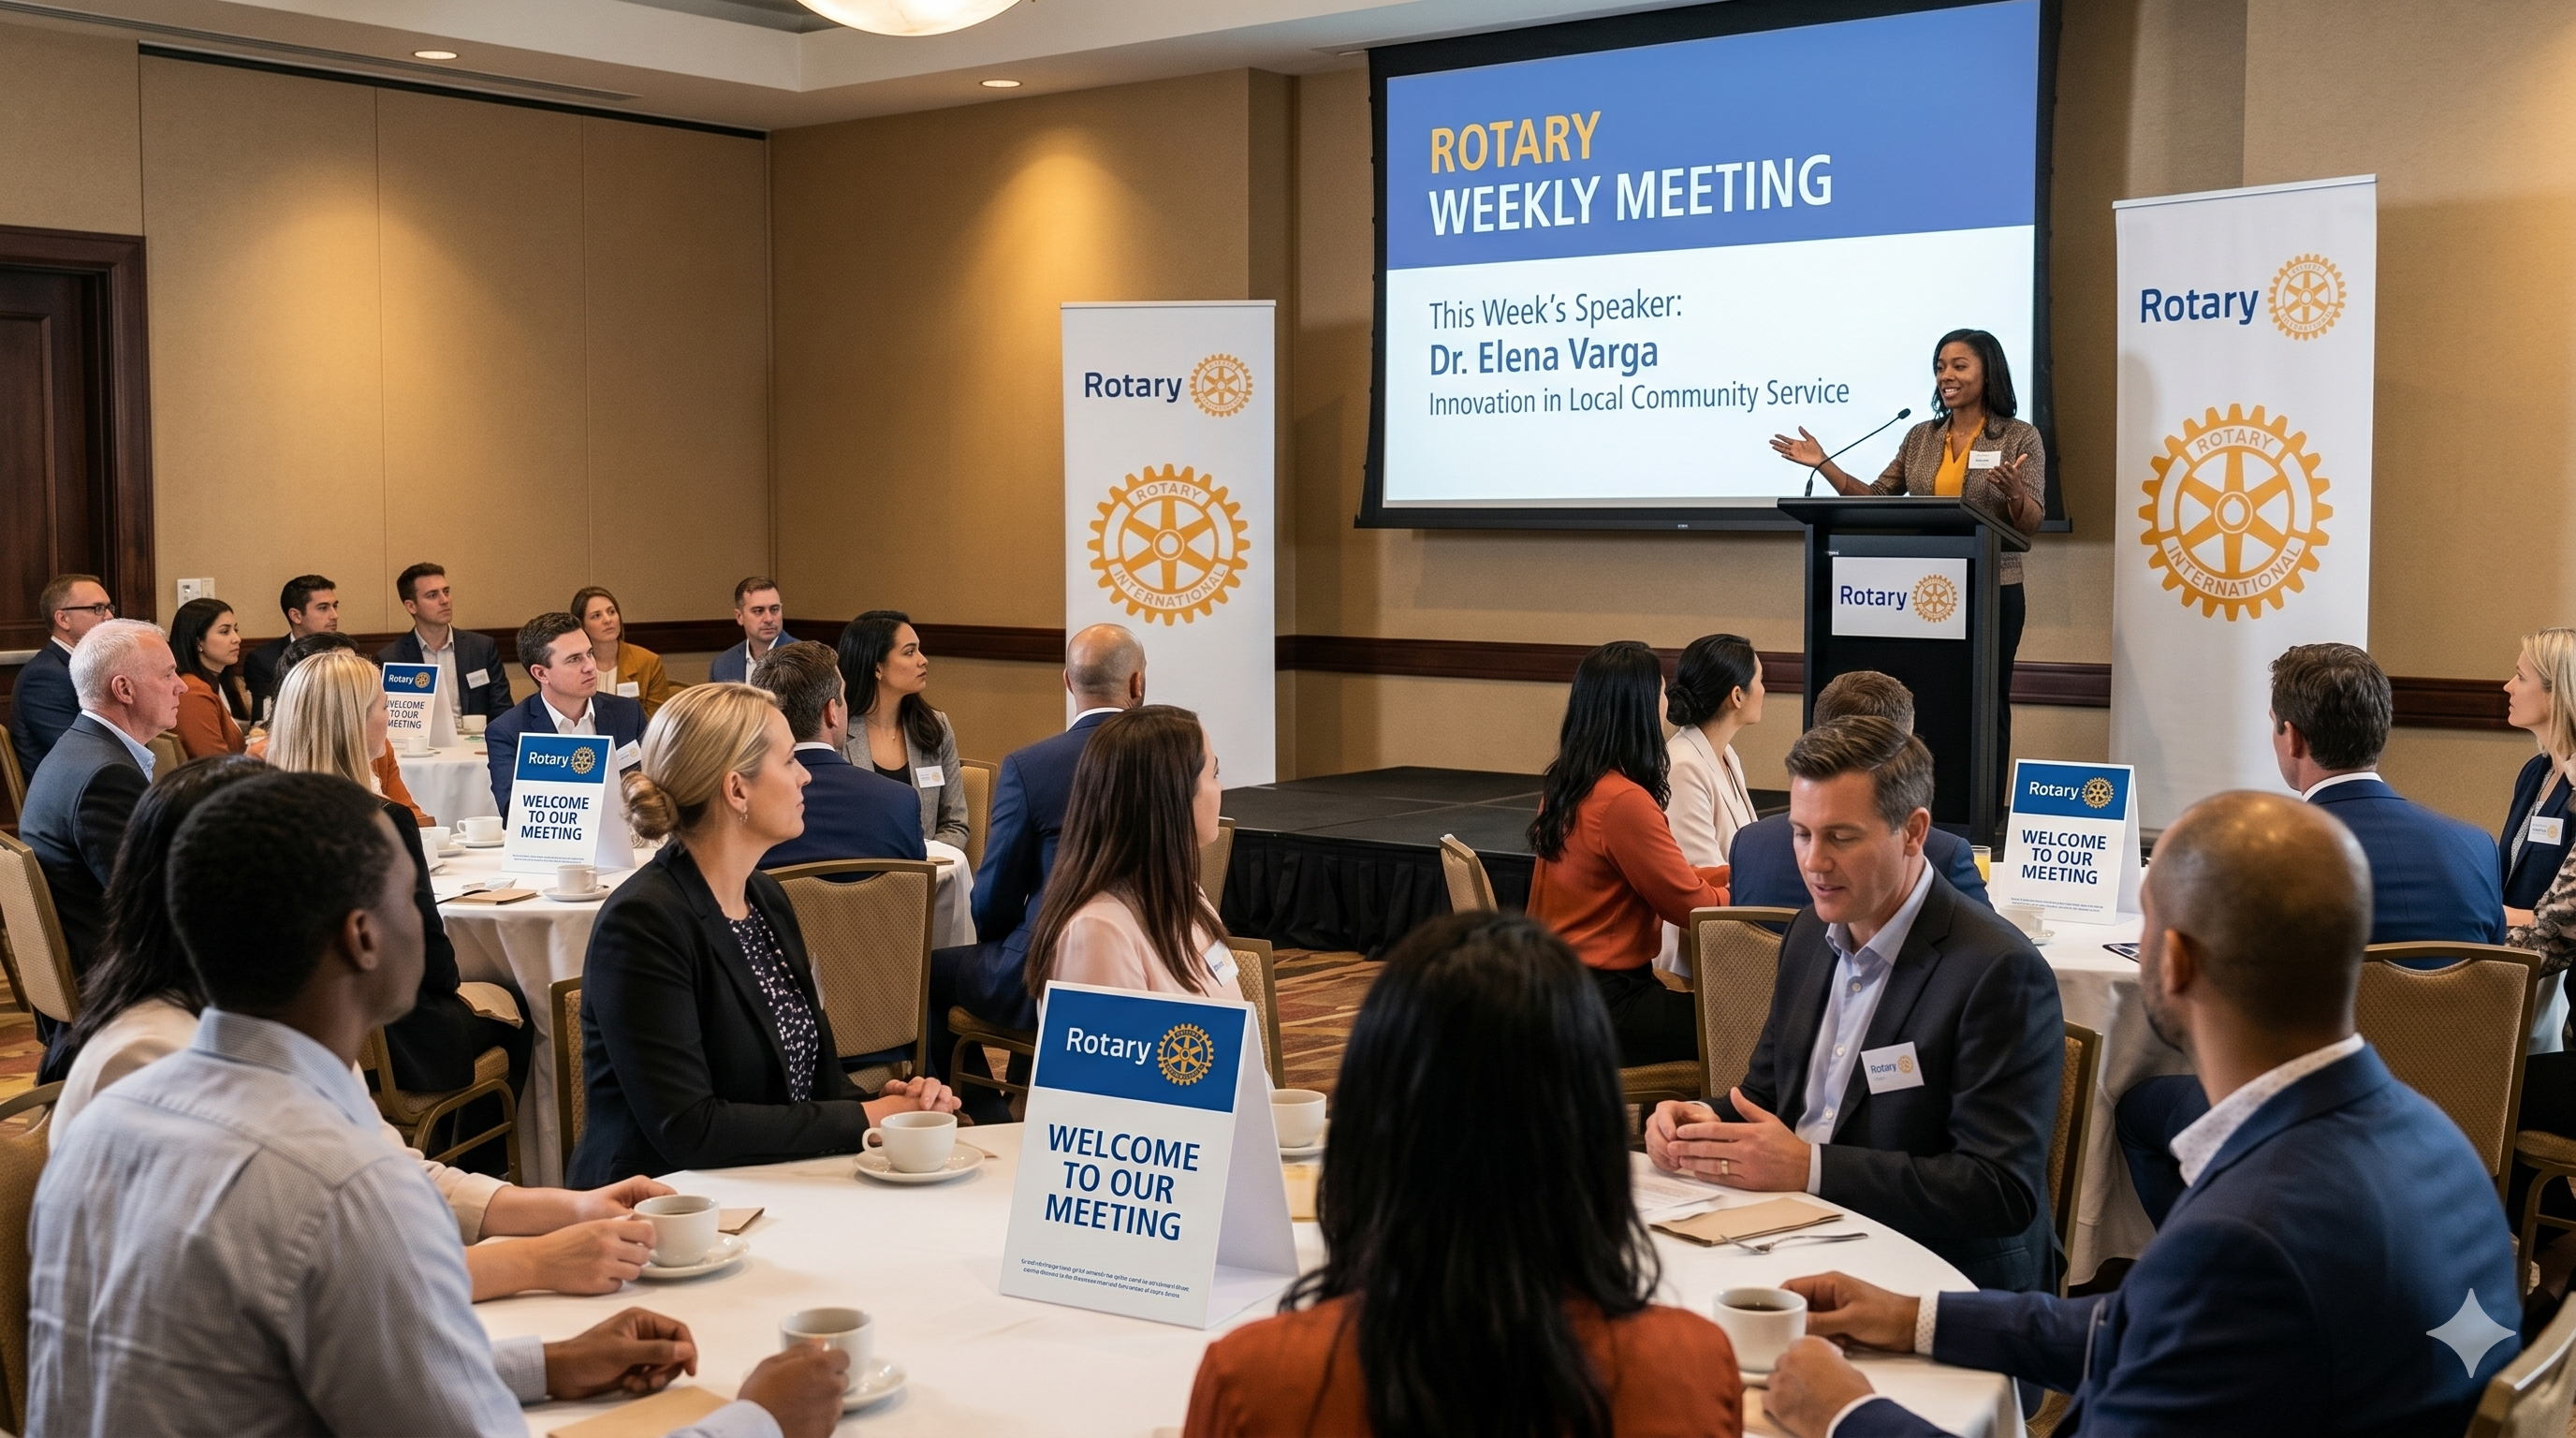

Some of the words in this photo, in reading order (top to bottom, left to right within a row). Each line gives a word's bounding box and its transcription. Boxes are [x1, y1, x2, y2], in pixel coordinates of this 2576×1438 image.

[1429, 110, 1602, 174] ROTARY
[1428, 175, 1601, 236] WEEKLY
[1616, 154, 1833, 221] MEETING
[1429, 301, 1475, 330] This
[1482, 294, 1567, 326] Week's
[1574, 288, 1683, 329] Speaker:
[2140, 287, 2260, 326] Rotary
[1430, 344, 1468, 376] Dr.
[1478, 339, 1559, 374] Elena
[1568, 337, 1659, 376] Varga
[1084, 372, 1183, 404] Rotary
[1429, 389, 1536, 416] Innovation
[1543, 388, 1561, 413] in
[1569, 384, 1624, 412] Local
[1631, 380, 1759, 413] Community
[1766, 377, 1850, 406] Service
[2196, 429, 2276, 455] ROTARY
[1134, 482, 1203, 503] ROTARY
[2167, 544, 2303, 597] INTERNATIONAL
[1113, 567, 1227, 609] INTERNATIONAL
[1839, 585, 1908, 611] Rotary
[388, 674, 414, 684] Rotary
[388, 720, 421, 729] MEETING
[390, 710, 401, 718] TO
[402, 711, 418, 719] OUR
[528, 752, 569, 769] Rotary
[522, 795, 590, 810] WELCOME
[2028, 781, 2080, 800] Rotary
[528, 811, 546, 823] TO
[549, 812, 578, 825] OUR
[520, 826, 582, 841] MEETING
[2022, 829, 2107, 850] WELCOME
[2032, 847, 2053, 862] TO
[2057, 850, 2093, 867] OUR
[2022, 864, 2098, 885] MEETING
[1066, 1027, 1151, 1065] Rotary
[1870, 1064, 1896, 1074] Rotary
[1048, 1123, 1201, 1172] WELCOME
[1062, 1161, 1101, 1192] TO
[1110, 1168, 1175, 1204] OUR
[1045, 1194, 1181, 1241] MEETING
